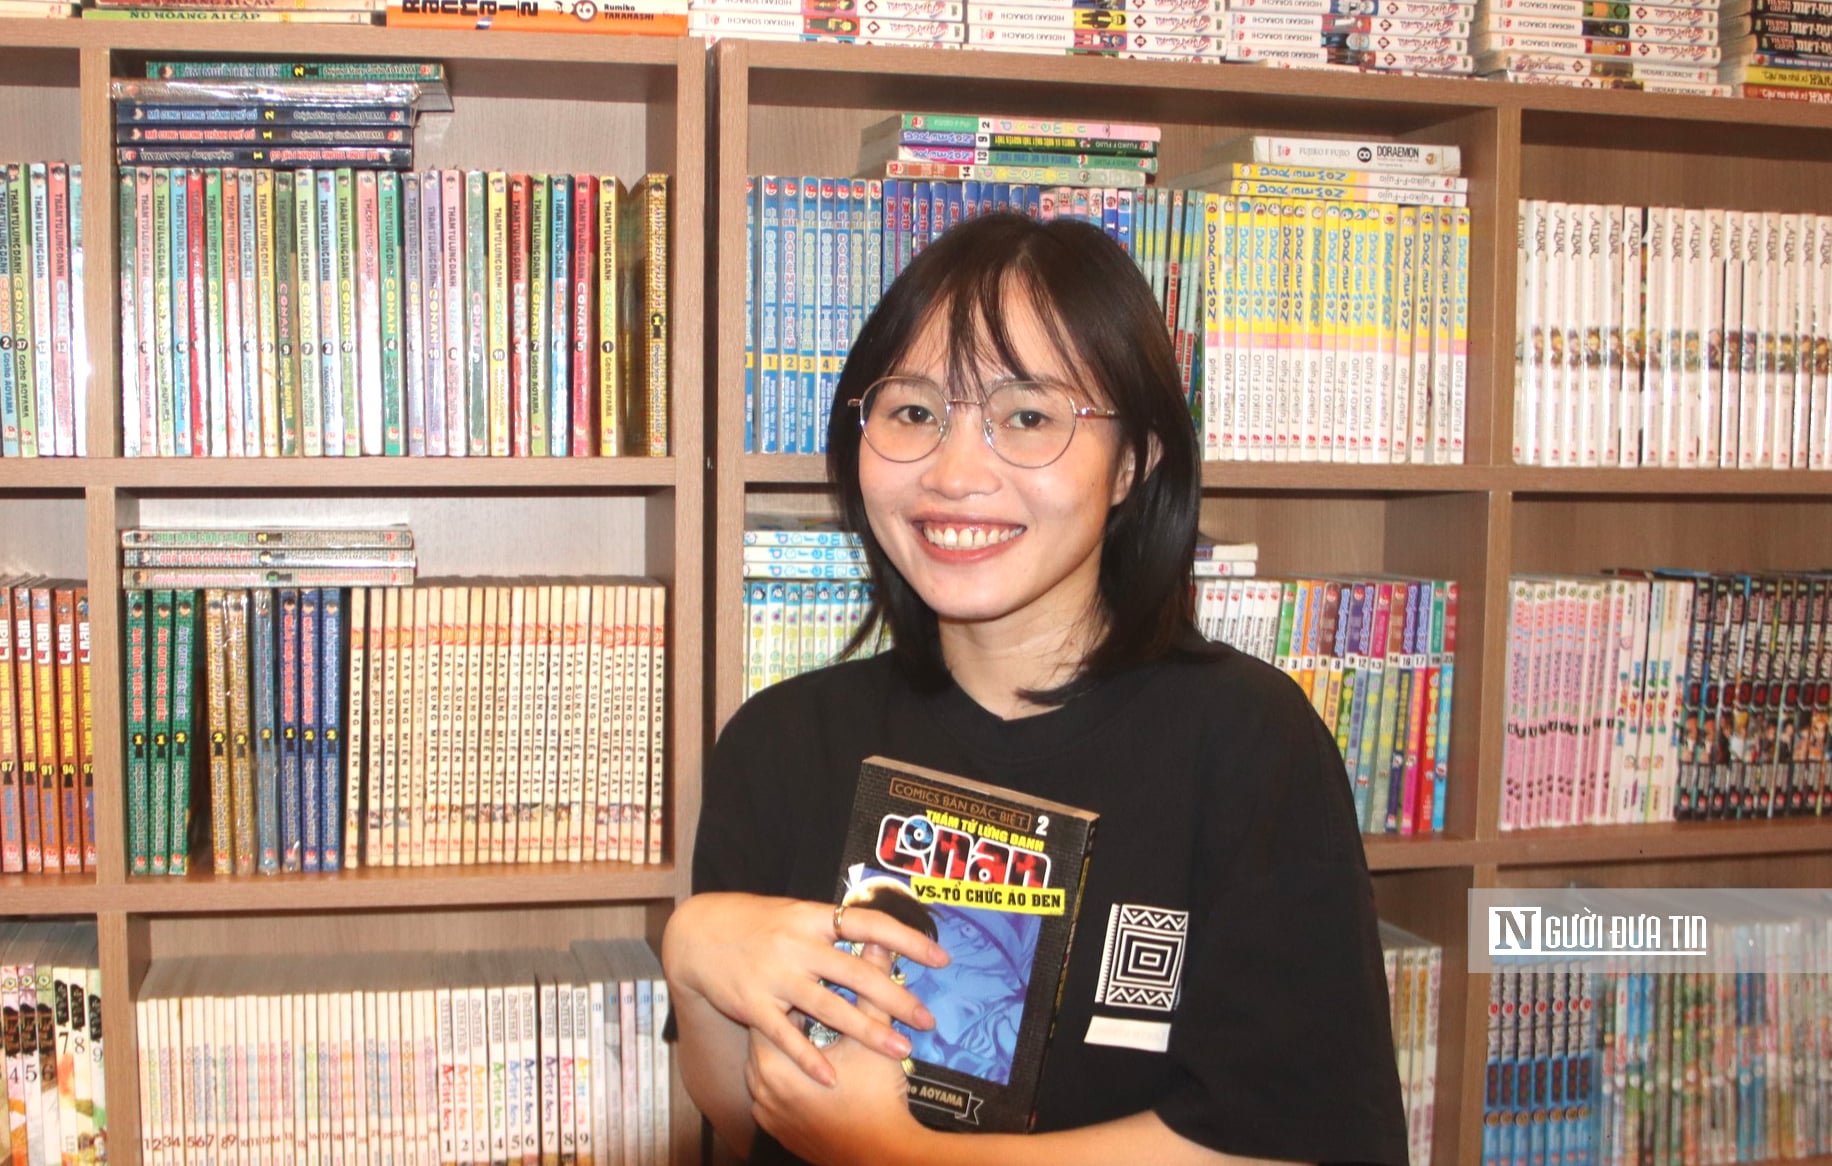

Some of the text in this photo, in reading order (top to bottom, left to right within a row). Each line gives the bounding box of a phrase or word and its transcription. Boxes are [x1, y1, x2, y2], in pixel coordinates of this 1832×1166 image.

[604, 3, 635, 12] Rumiko
[977, 151, 988, 162] 13
[1377, 145, 1419, 158] DORAEMON
[962, 166, 970, 178] 14
[1553, 210, 1566, 257] ALTAIR
[1588, 212, 1600, 259] ALTAIR
[1689, 217, 1702, 264] ALTAIR
[1710, 216, 1722, 263] ALTAIR
[1783, 222, 1796, 268] ALTAIR
[14, 276, 25, 334] CONAN
[577, 281, 587, 336] CONAN
[3, 352, 12, 378] Gosho
[18, 354, 27, 381] Gosho
[787, 357, 793, 367] 2
[804, 359, 811, 370] 3
[823, 360, 829, 368] 4
[4, 380, 13, 414] AOYAMA
[20, 383, 29, 418] AOYAMA
[532, 382, 540, 414] AOYAMA
[605, 384, 613, 417] AOYAMA
[894, 783, 940, 805] COMICS
[926, 809, 960, 828] THÁM
[978, 822, 1009, 842] LỪNG
[1010, 832, 1045, 852] DANH
[1035, 814, 1050, 836] 2
[966, 888, 1003, 904] CHỨC
[1031, 894, 1061, 908] ĐEN
[58, 1032, 69, 1055] 7
[75, 1038, 84, 1054] 8
[93, 1047, 102, 1062] 9
[9, 1067, 18, 1084] 4
[25, 1065, 37, 1082] 5
[42, 1064, 54, 1081] 6
[919, 1086, 963, 1107] AOYAMA
[446, 1140, 451, 1152] 1
[462, 1139, 469, 1152] 2
[477, 1140, 485, 1152] 3
[495, 1138, 503, 1150] 4
[512, 1136, 520, 1149] 5
[526, 1134, 534, 1147] 6
[545, 1132, 554, 1144] 7
[564, 1133, 573, 1145] 8
[580, 1132, 588, 1144] 9
